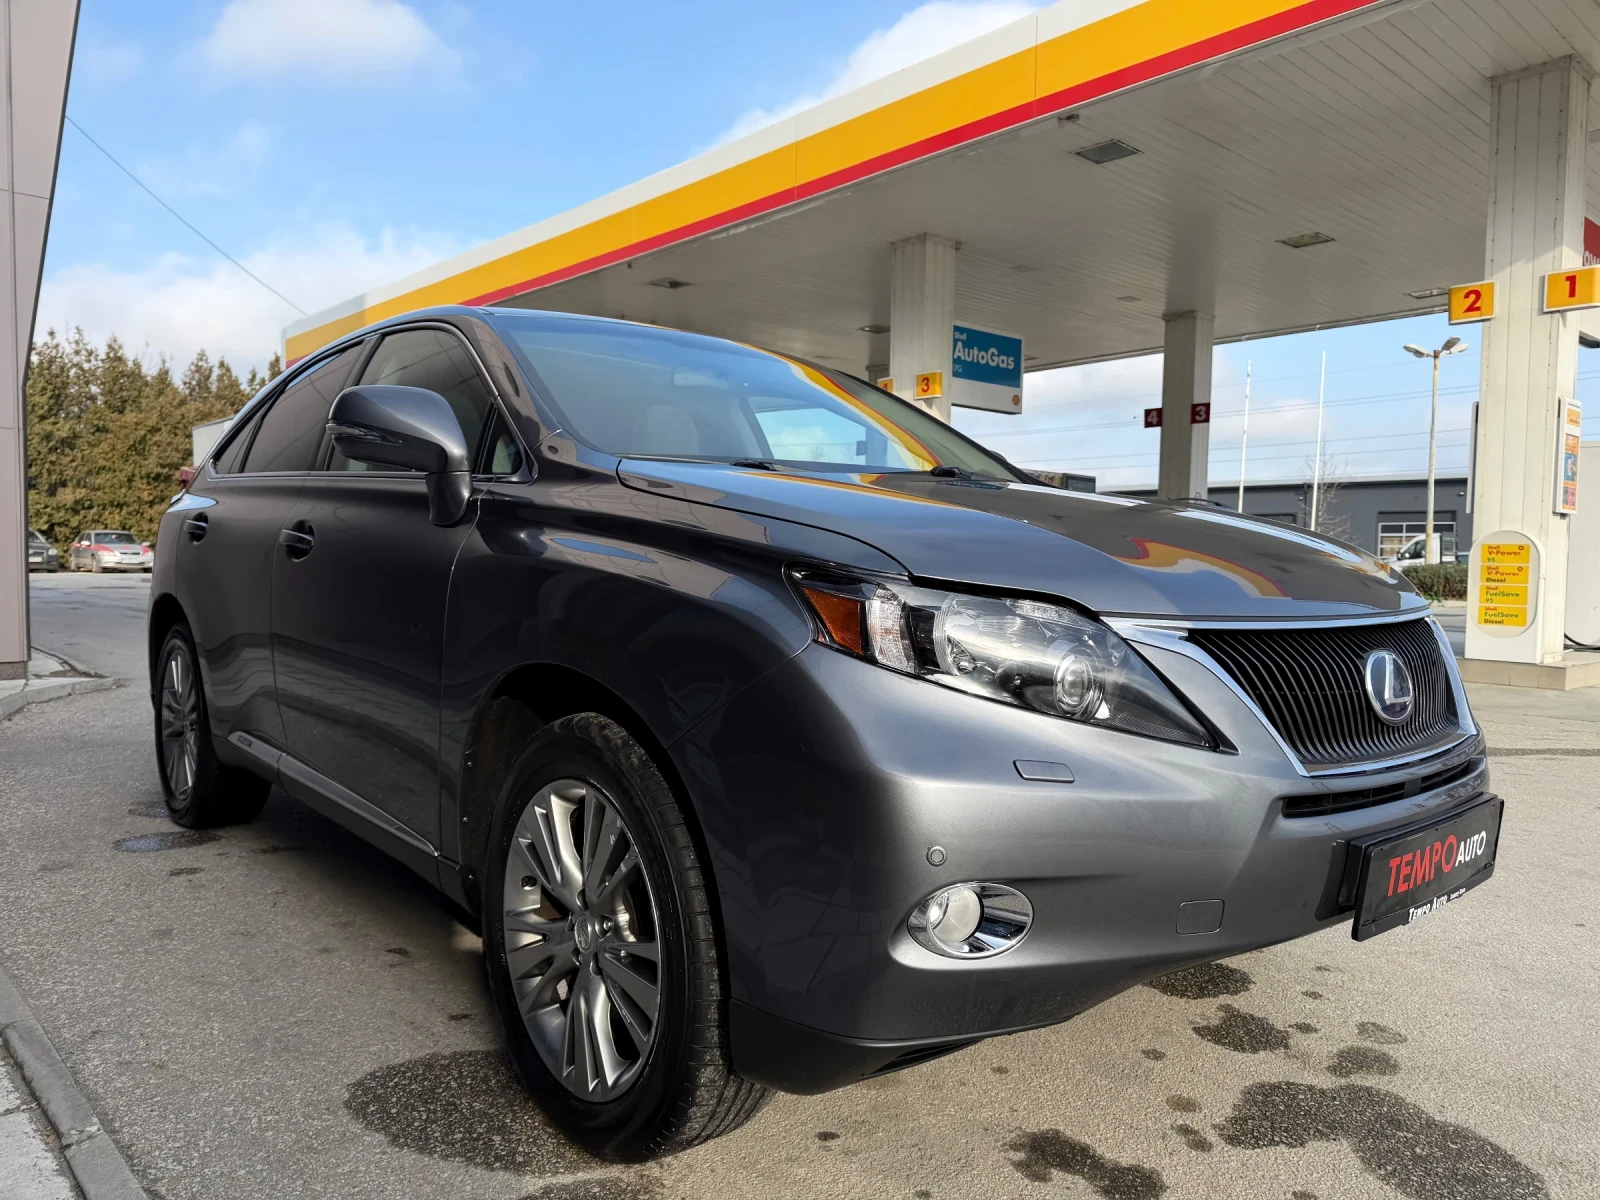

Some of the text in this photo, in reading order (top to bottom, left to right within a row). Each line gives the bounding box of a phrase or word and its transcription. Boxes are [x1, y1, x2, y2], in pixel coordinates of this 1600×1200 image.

[1565, 275, 1577, 298] 1
[1463, 289, 1482, 313] 2
[954, 341, 1014, 369] AutoGas
[921, 376, 930, 393] 3
[1147, 411, 1158, 425] 4
[1195, 405, 1206, 421] 3
[1388, 830, 1486, 897] TEMPO AUTO
